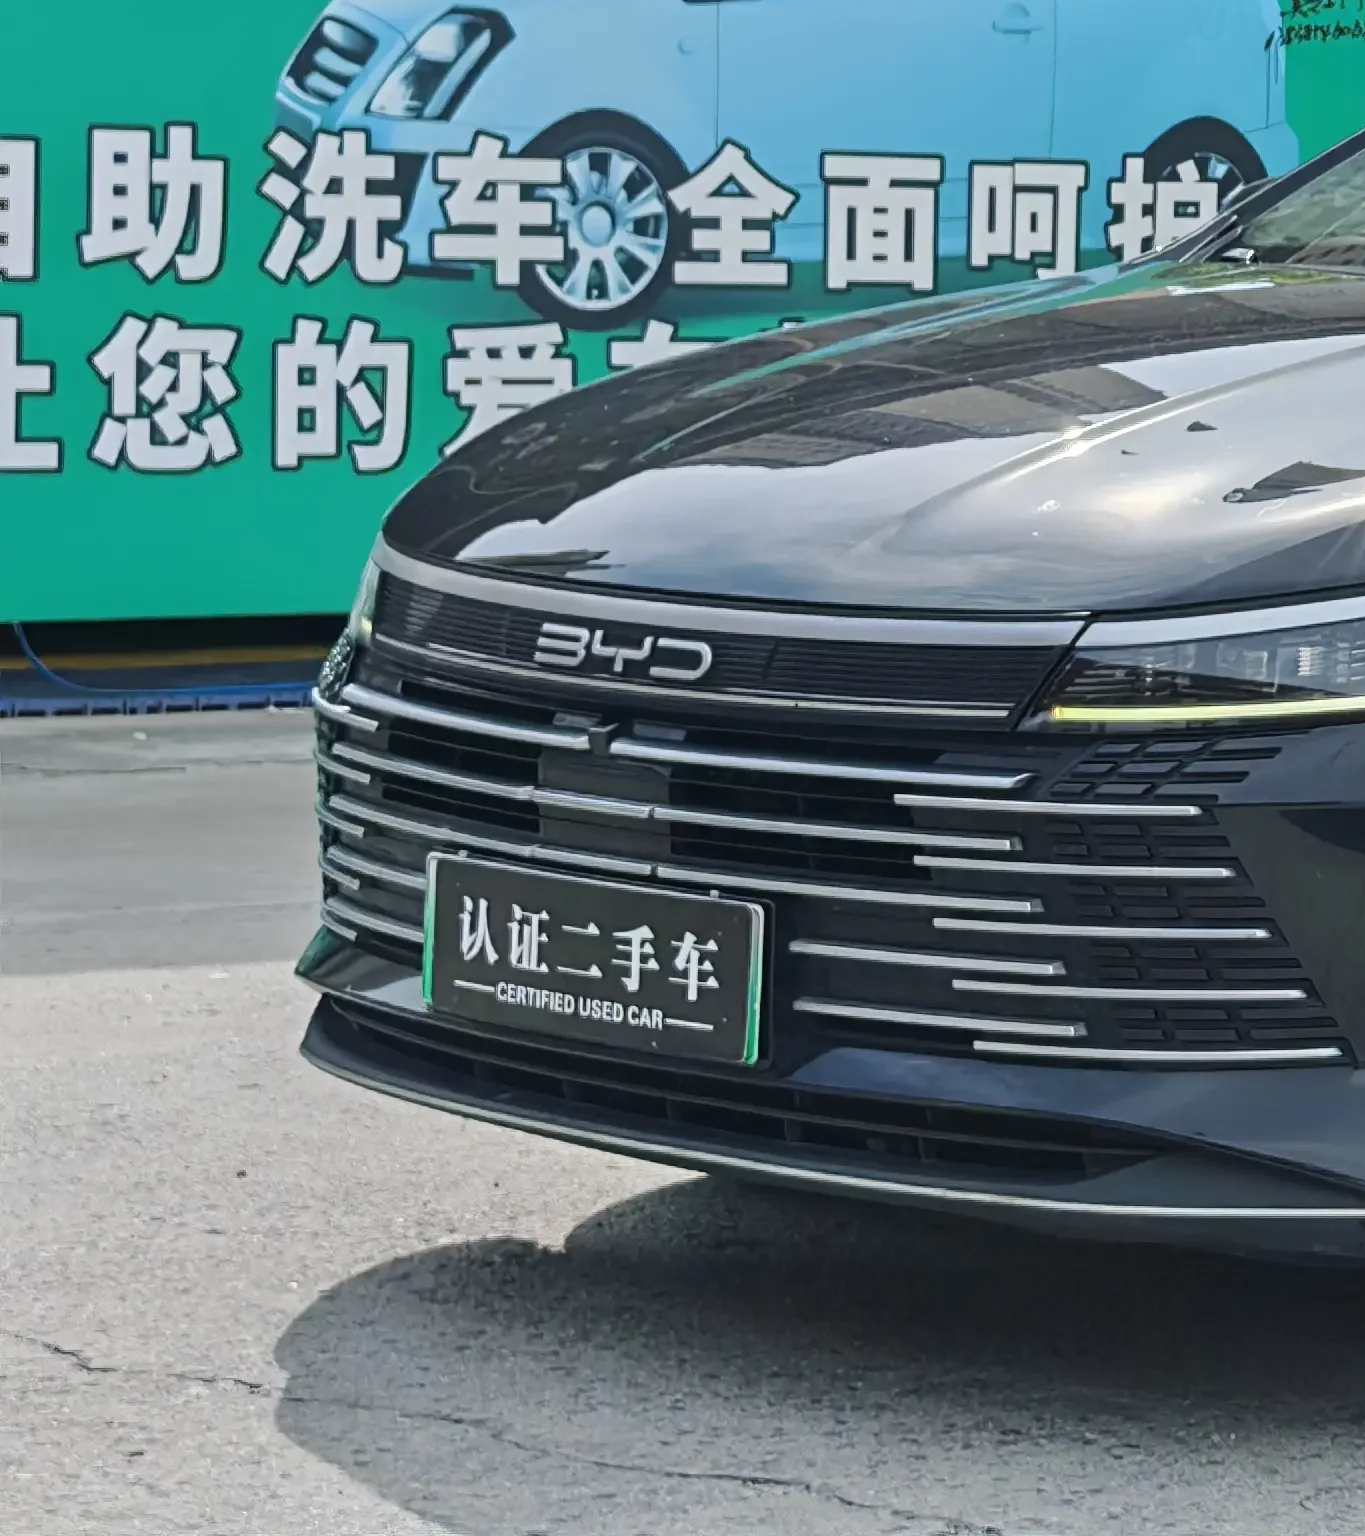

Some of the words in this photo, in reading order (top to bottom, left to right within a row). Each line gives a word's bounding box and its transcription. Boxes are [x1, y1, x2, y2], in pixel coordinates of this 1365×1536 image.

[666, 140, 1219, 291] 全面呵护
[533, 622, 713, 681] BYD
[457, 895, 721, 1003] 认证二手车
[495, 981, 576, 1015] CERTIFIED
[577, 995, 625, 1024] USED
[626, 1005, 664, 1031] CAR
